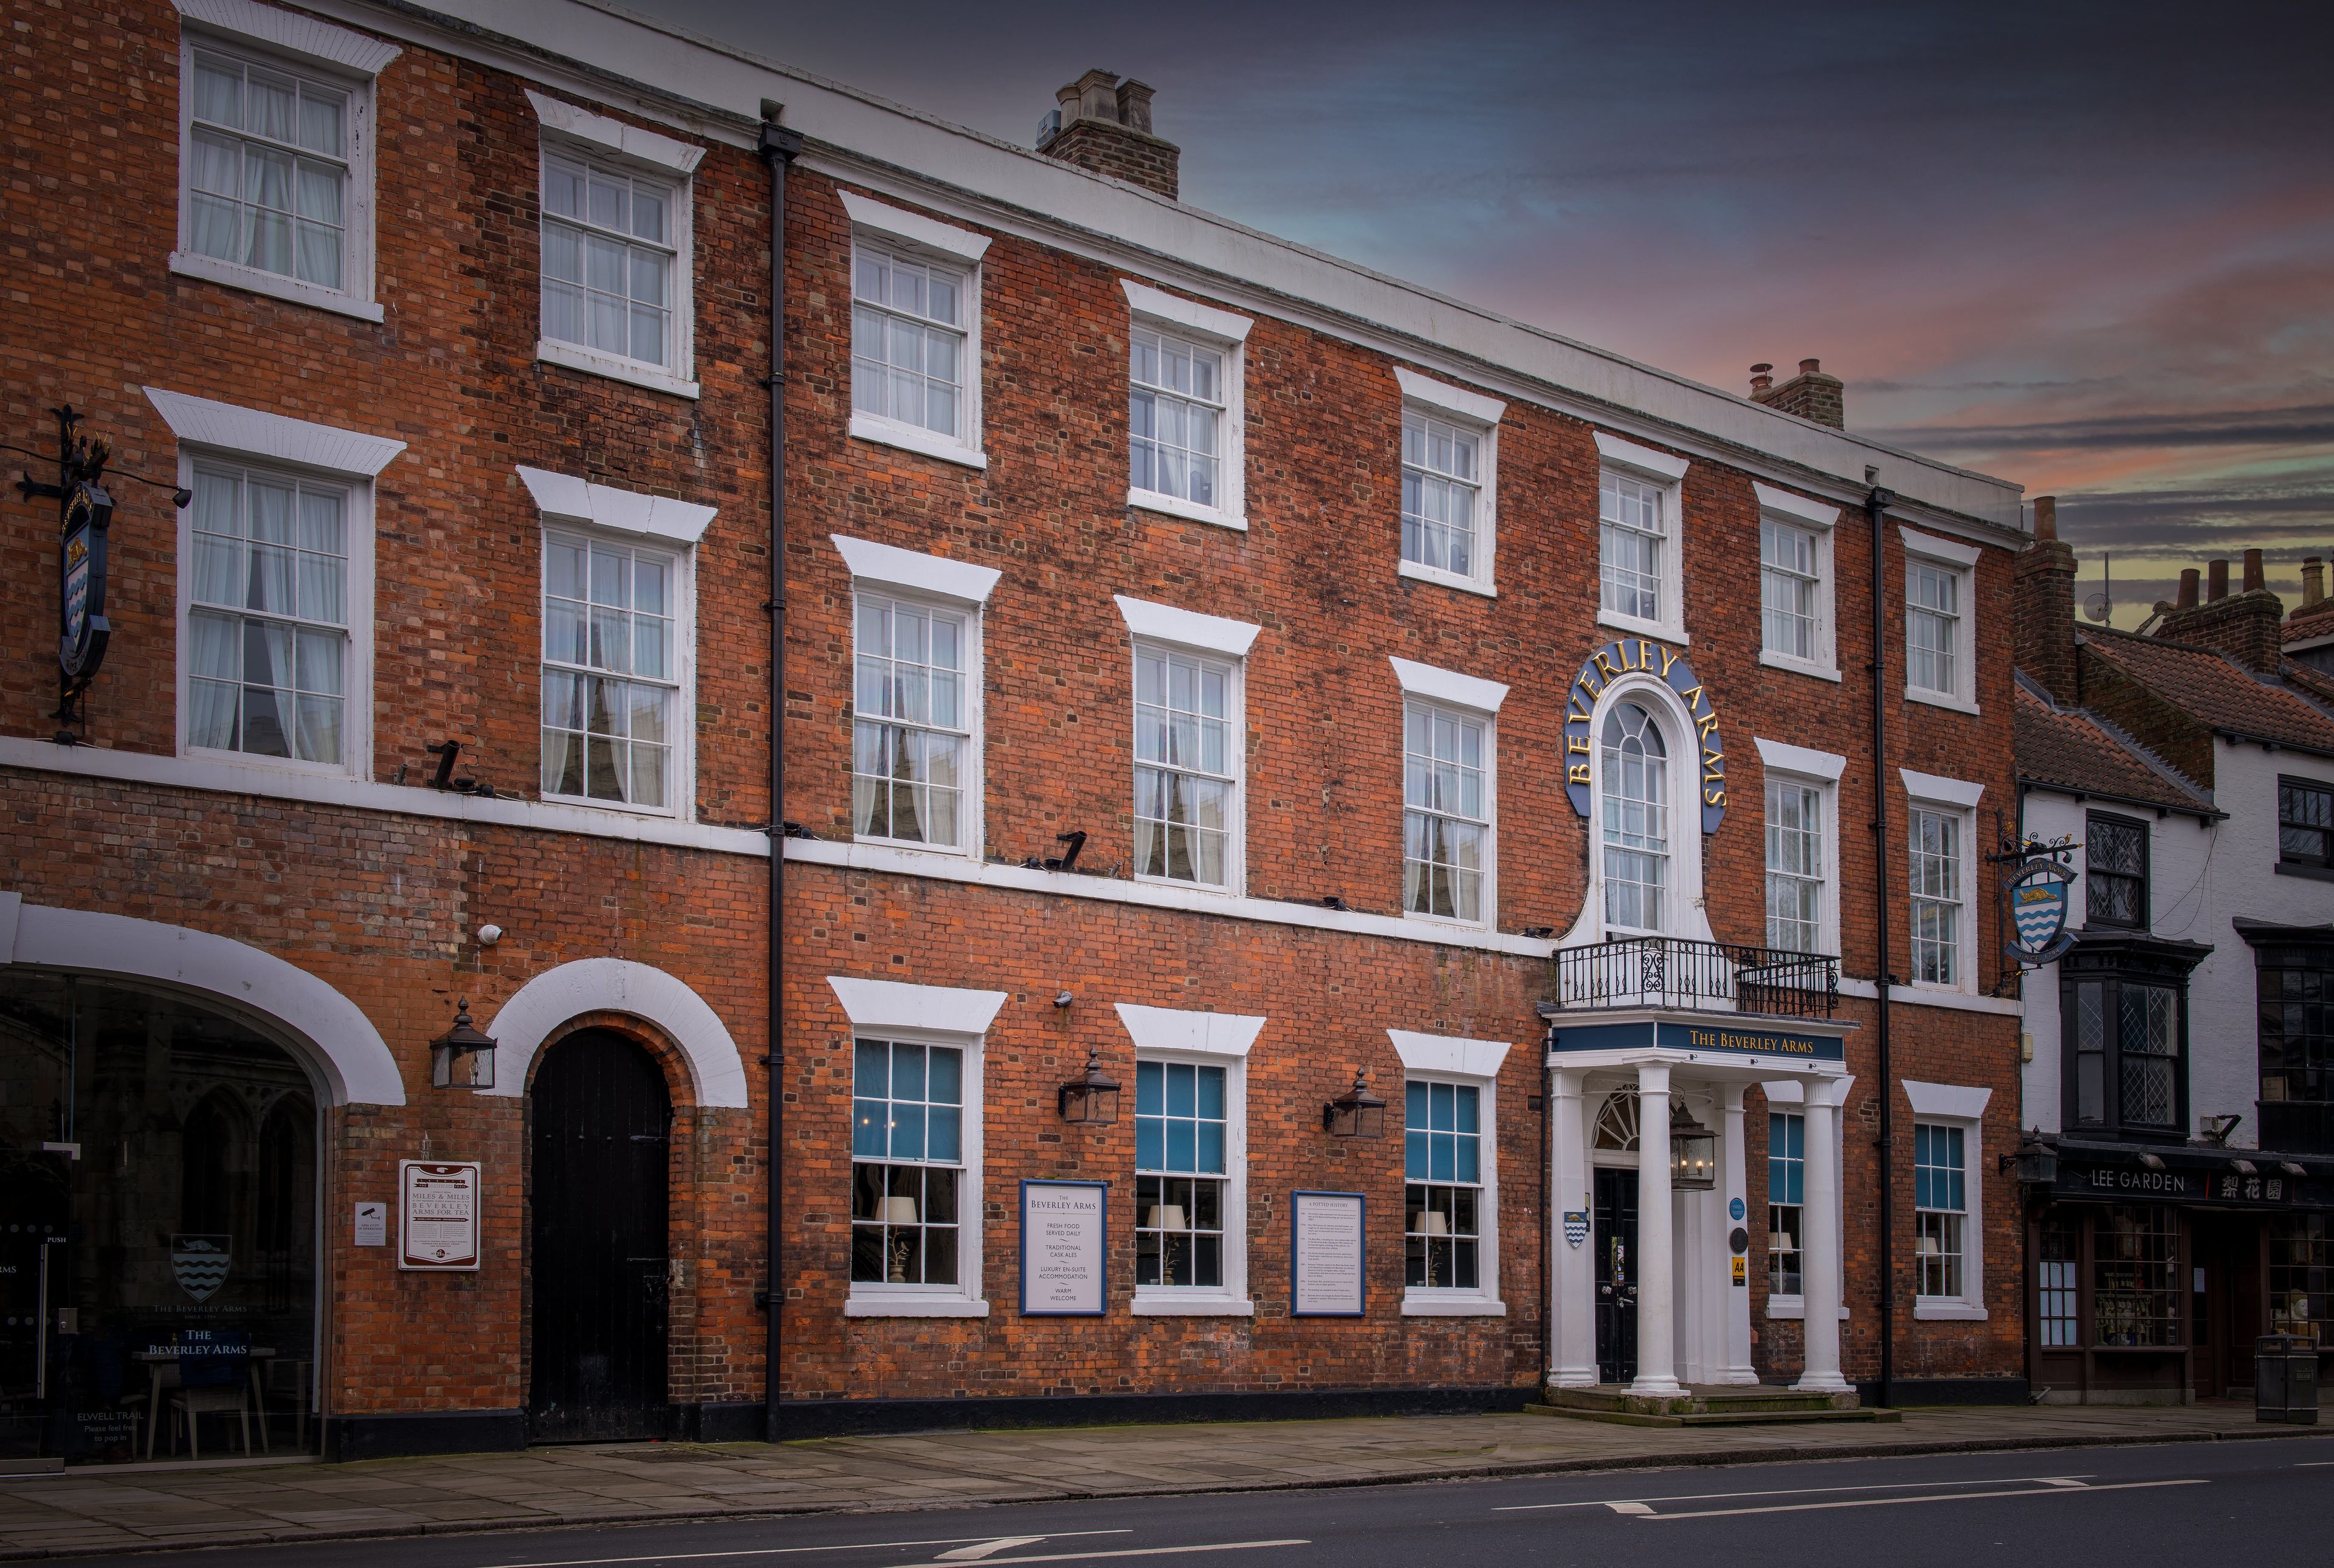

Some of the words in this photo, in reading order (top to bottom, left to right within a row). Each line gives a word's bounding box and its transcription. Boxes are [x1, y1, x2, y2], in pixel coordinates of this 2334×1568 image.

[1568, 640, 1679, 786] BEVERLEY
[1681, 685, 1727, 807] ARMS
[2008, 863, 2043, 885] BEVERLEY
[2047, 863, 2067, 877] ARMS
[1690, 1030, 1716, 1047] THE
[1720, 1033, 1778, 1052] BEVERLEY
[1780, 1037, 1814, 1054] ARMS
[2092, 1169, 2114, 1188] LEE
[2119, 1171, 2184, 1192] GARDEN
[2221, 1175, 2282, 1201] 梨花園
[1031, 1200, 1071, 1209] BEVERLEY
[1073, 1202, 1096, 1210] ARMS
[1734, 1262, 1744, 1273] AA
[185, 1330, 212, 1340] THE
[149, 1344, 210, 1355] BEVERLEY
[212, 1344, 247, 1355] ARMS
[77, 1412, 115, 1422] ELWELL
[115, 1411, 144, 1420] TRAIL
